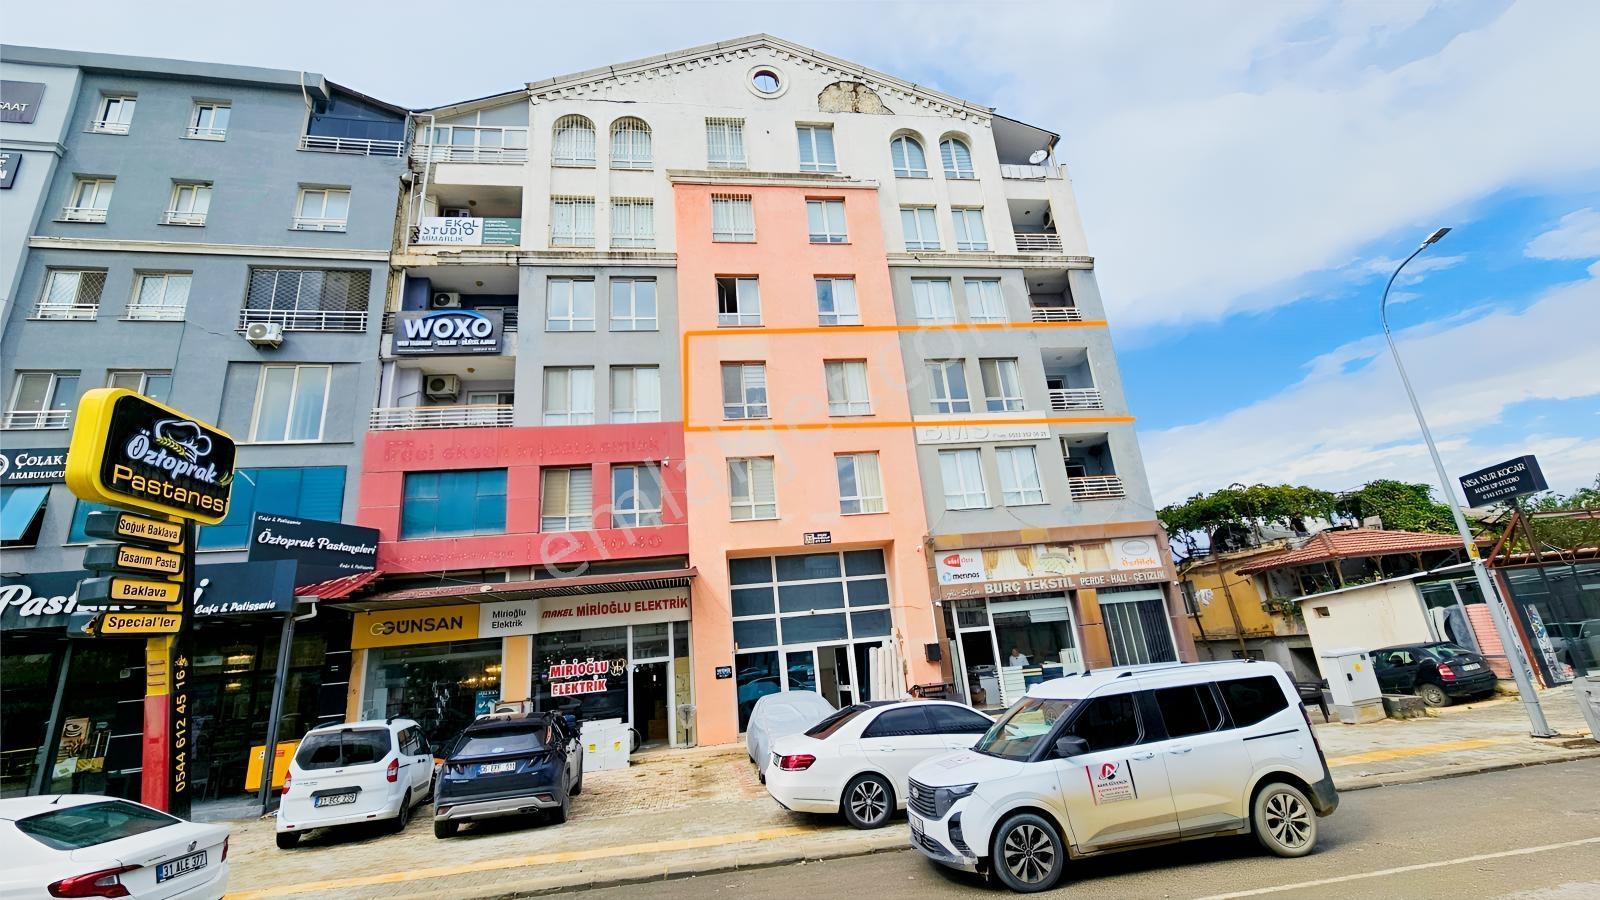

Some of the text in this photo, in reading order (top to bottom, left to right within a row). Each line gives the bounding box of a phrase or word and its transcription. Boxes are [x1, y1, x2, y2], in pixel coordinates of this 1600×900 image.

[423, 226, 475, 236] STUDIO
[445, 219, 479, 231] EKOL
[403, 318, 493, 339] WOXO
[15, 453, 63, 469] ÇOLAK
[126, 429, 218, 485] Öztoprak
[112, 463, 230, 513] Pastanesi
[119, 518, 178, 539] Soğuk Baklava
[257, 528, 377, 555] Öztoprak Pastaneleri
[119, 550, 177, 569] Tasarım Pasta
[123, 584, 167, 598] Baklava
[984, 580, 1021, 595] BURÇ
[1080, 575, 1105, 586] PERDE
[194, 600, 276, 615] Cafe & Patisserie
[492, 608, 527, 619] Mirioğlu
[576, 600, 631, 617] MİRİOĞLU
[634, 596, 689, 612] ELEKTRİK
[108, 616, 177, 630] Special'ler
[381, 615, 464, 635] GÜNSAN
[491, 620, 523, 629] Elektrik
[549, 658, 609, 679] MİRİOĞLU
[551, 675, 607, 697] ELEKTRİK
[175, 669, 187, 793] 0544 612 45 16
[162, 853, 205, 877] 31 ALE 377
